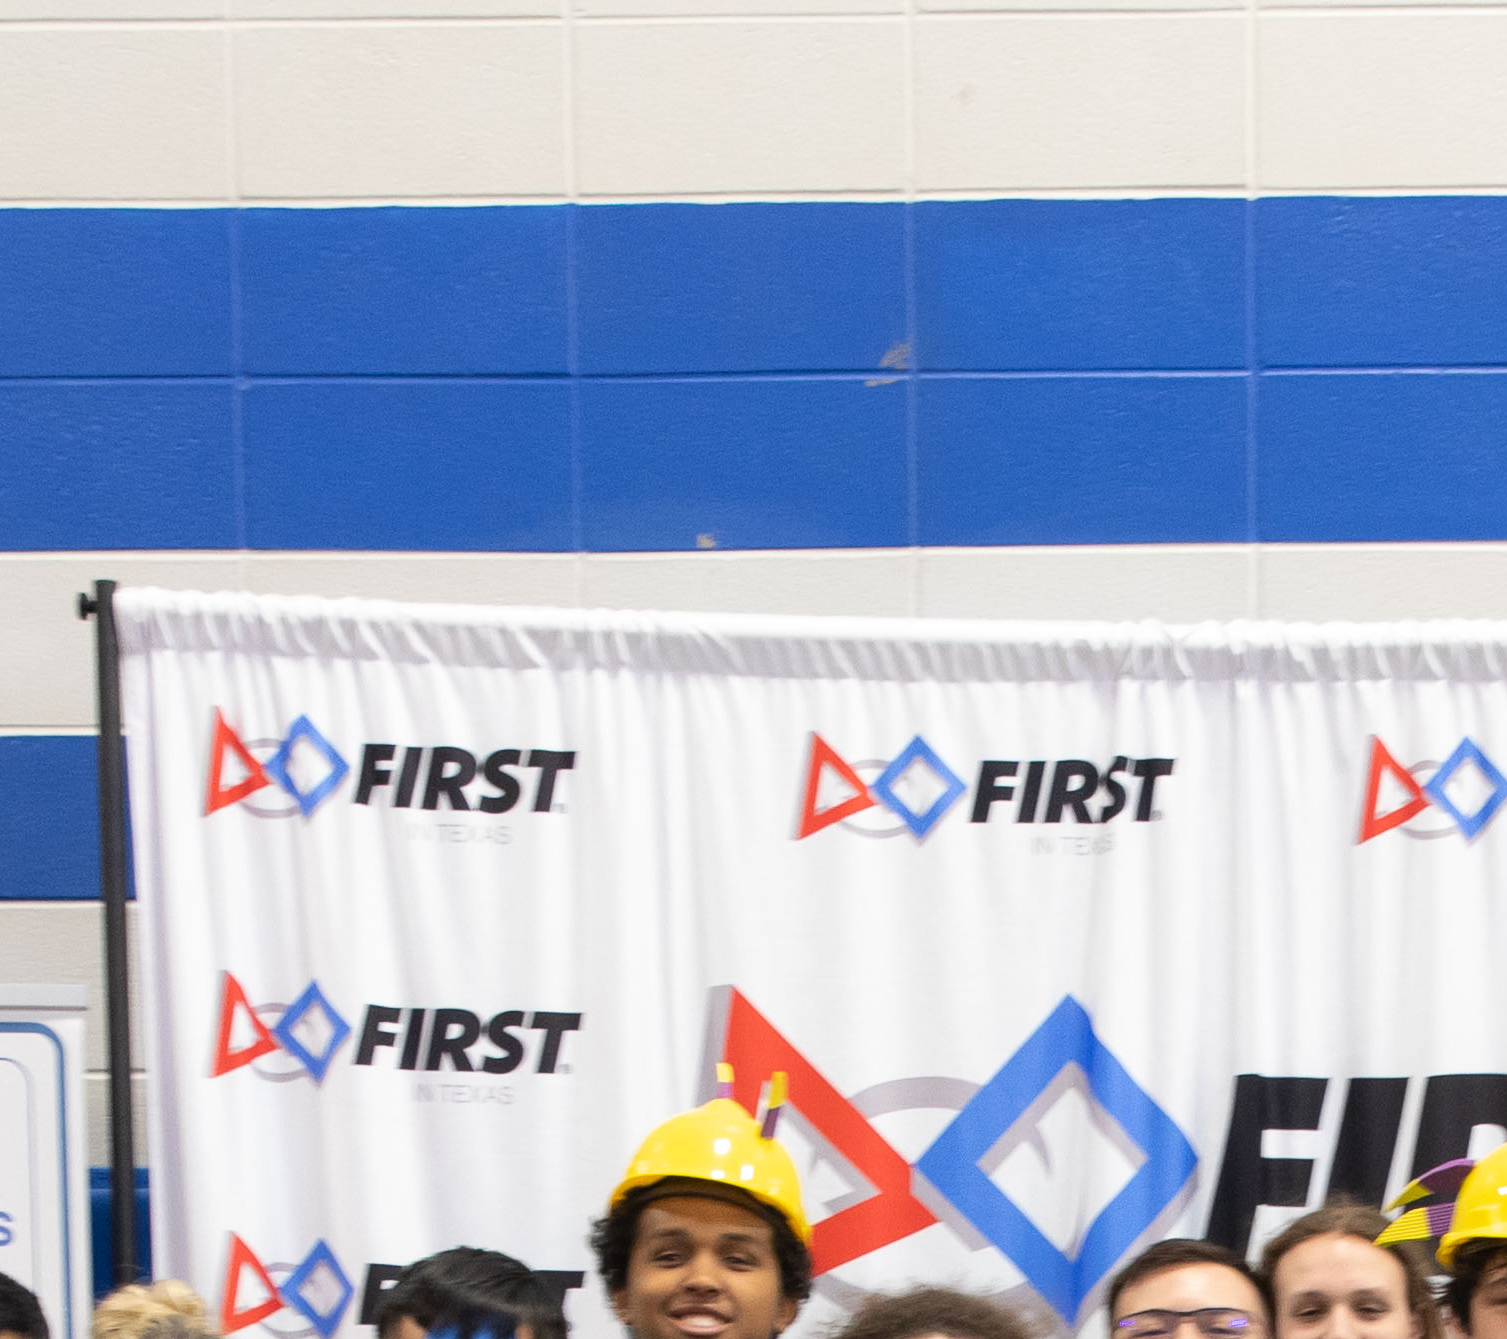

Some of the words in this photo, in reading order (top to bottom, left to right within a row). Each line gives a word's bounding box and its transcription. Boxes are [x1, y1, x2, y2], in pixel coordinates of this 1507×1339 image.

[354, 743, 576, 813] FIRST
[969, 757, 1176, 825] FIRST
[352, 1004, 582, 1074] FIRST
